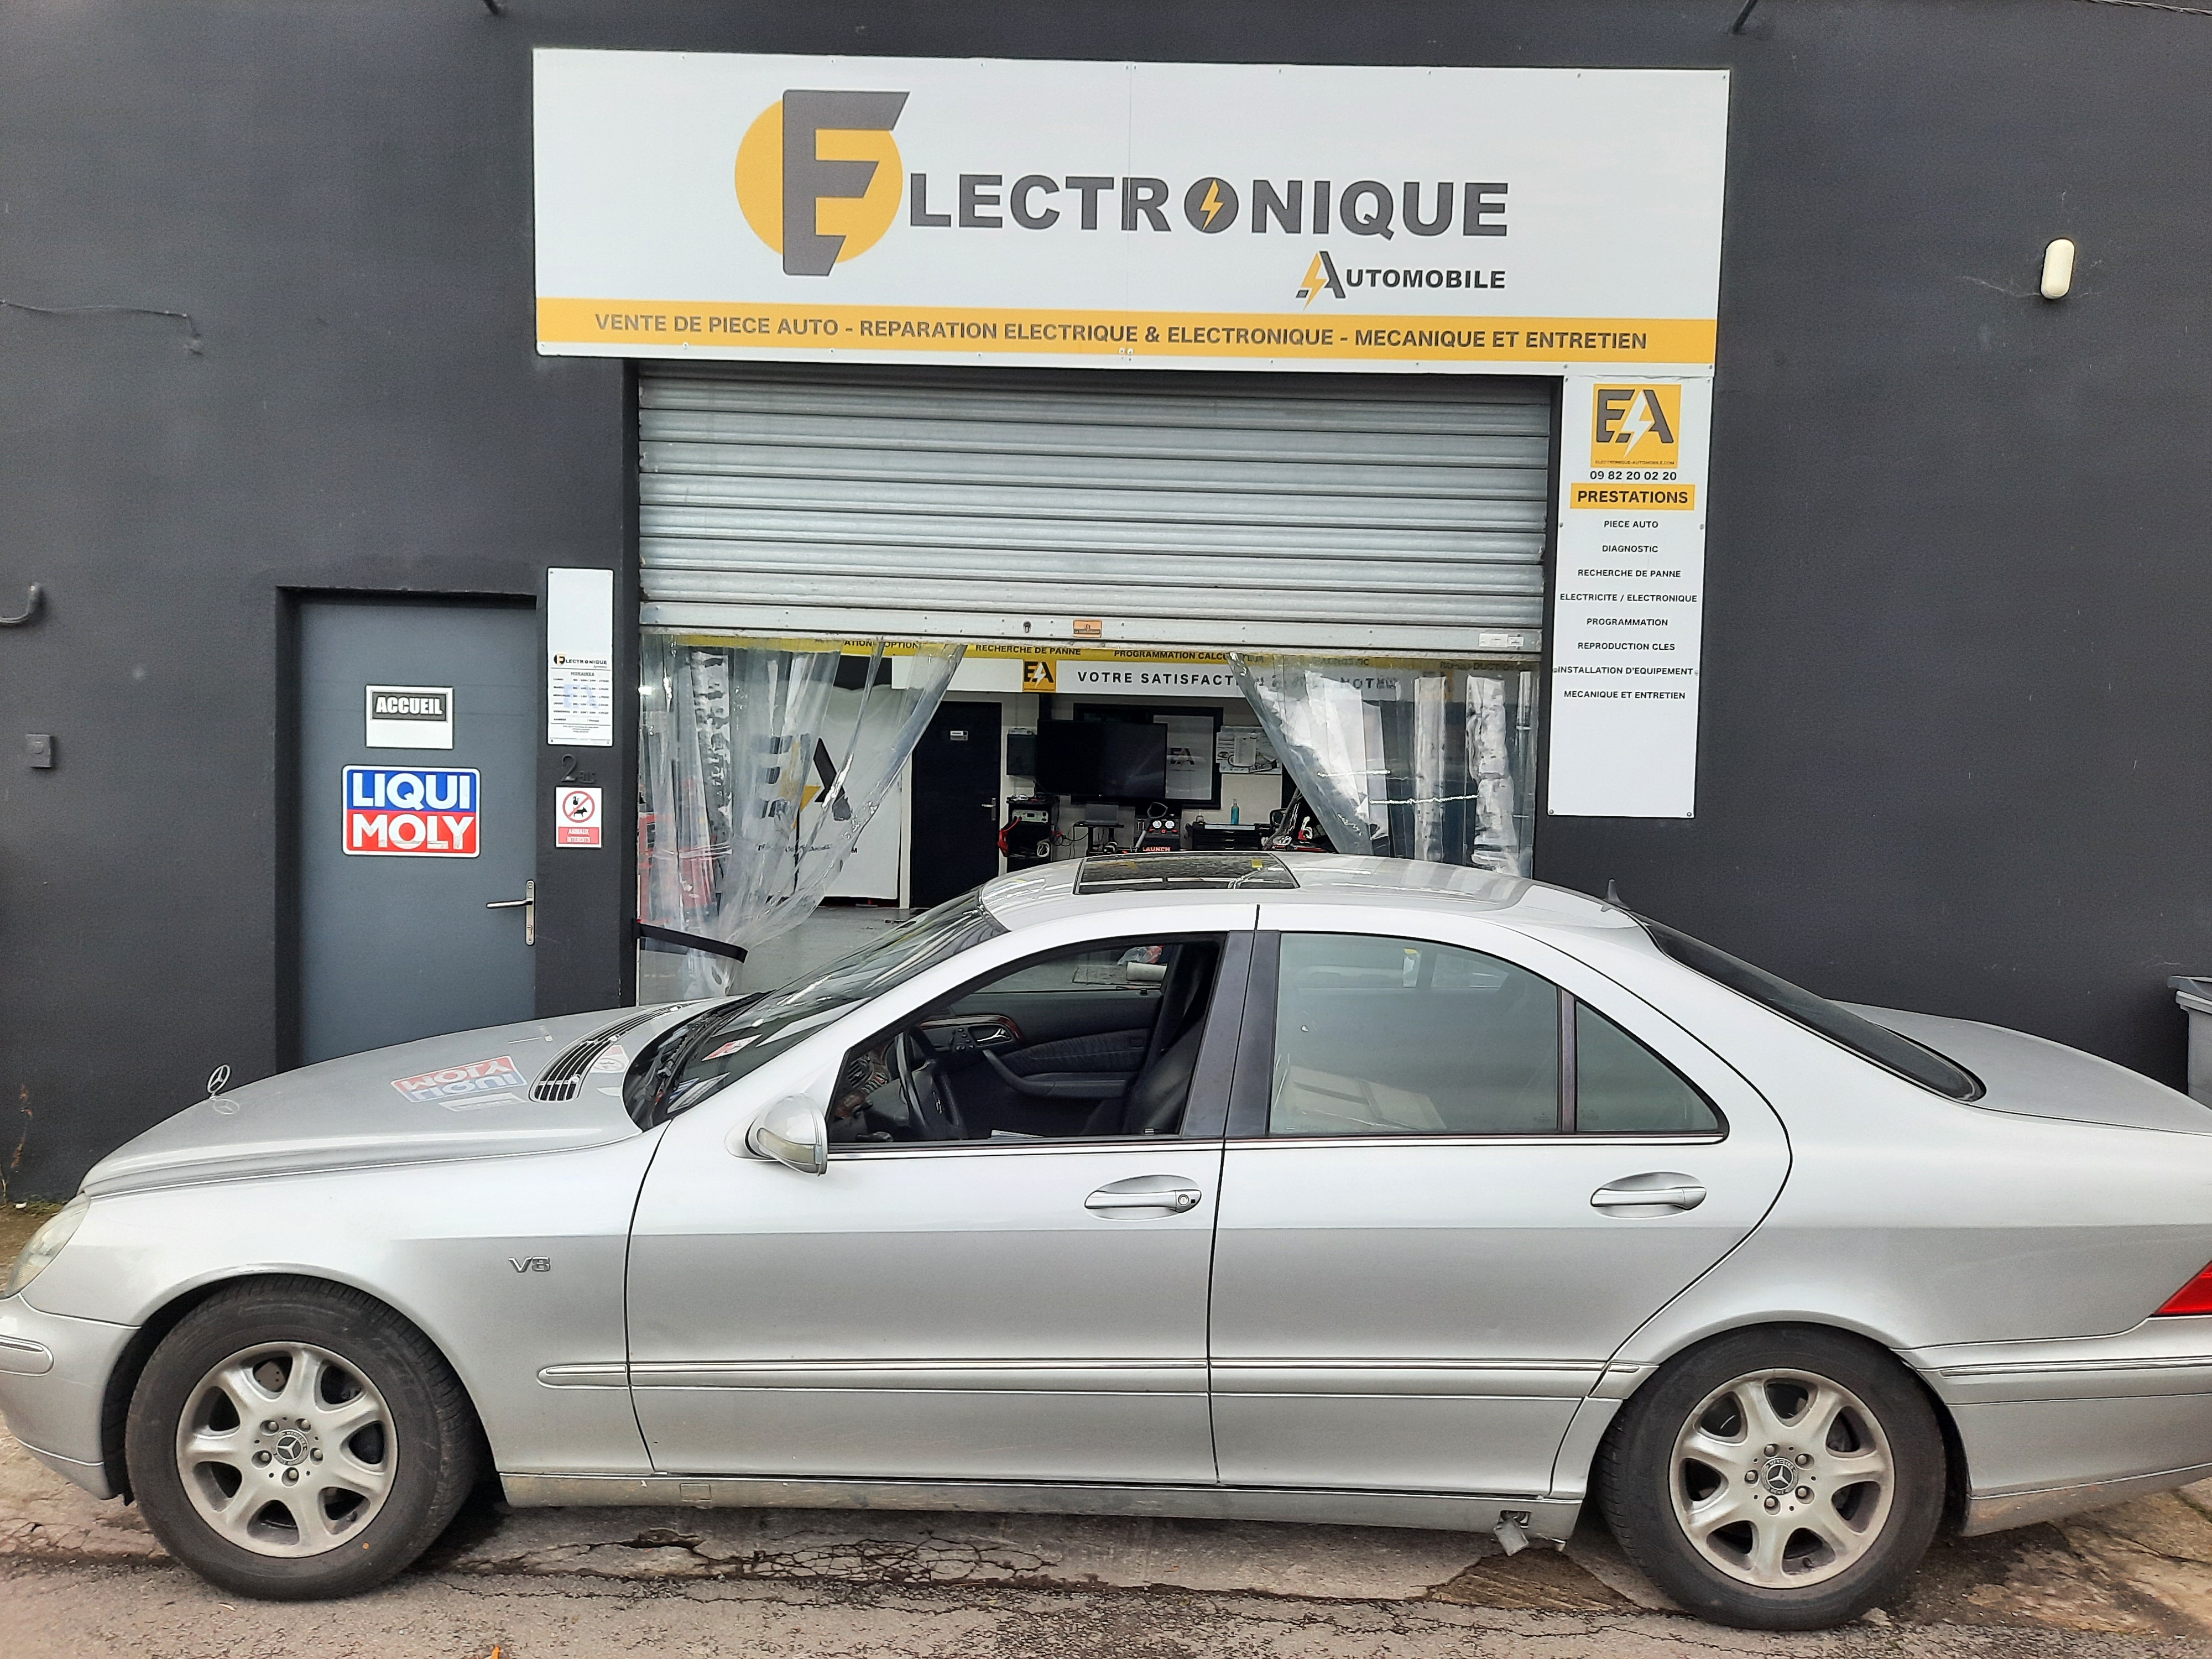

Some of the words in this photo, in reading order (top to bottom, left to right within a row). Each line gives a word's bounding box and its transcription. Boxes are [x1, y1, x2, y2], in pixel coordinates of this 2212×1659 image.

[1296, 251, 1506, 299] AUTOMOBILE
[595, 314, 666, 331] VENTE
[674, 315, 701, 332] DE
[709, 316, 770, 334] PIECE
[777, 319, 839, 336] AUTO
[860, 320, 997, 340] REPARATION
[1004, 323, 1138, 342] ELECTRIQUE
[1145, 326, 1160, 343] &
[1168, 326, 1333, 346] ELECTRONIQUE
[1355, 329, 1485, 348] MECANIQUE
[1493, 331, 1520, 348] ET
[1526, 332, 1646, 349] ENTRETIEN
[1596, 389, 1674, 444] EA
[1589, 471, 1605, 480] 09
[1608, 471, 1623, 480] 82
[1626, 471, 1641, 480] 20
[1644, 471, 1659, 481] 02
[1662, 472, 1677, 481] 20
[1577, 491, 1688, 504] PRESTATIONS
[1602, 545, 1658, 553] DIAGNOSTIC
[975, 645, 1031, 653] RECHERCHE
[1050, 647, 1081, 655] PANNE
[1114, 650, 1195, 659] PROGRAMMATION
[1024, 661, 1054, 683] EA
[1078, 671, 1133, 683] VOTRE
[375, 696, 443, 715] ACCUEIL
[353, 773, 471, 811] LIQUI
[353, 813, 474, 850] MOLY
[508, 1256, 551, 1273] V8
